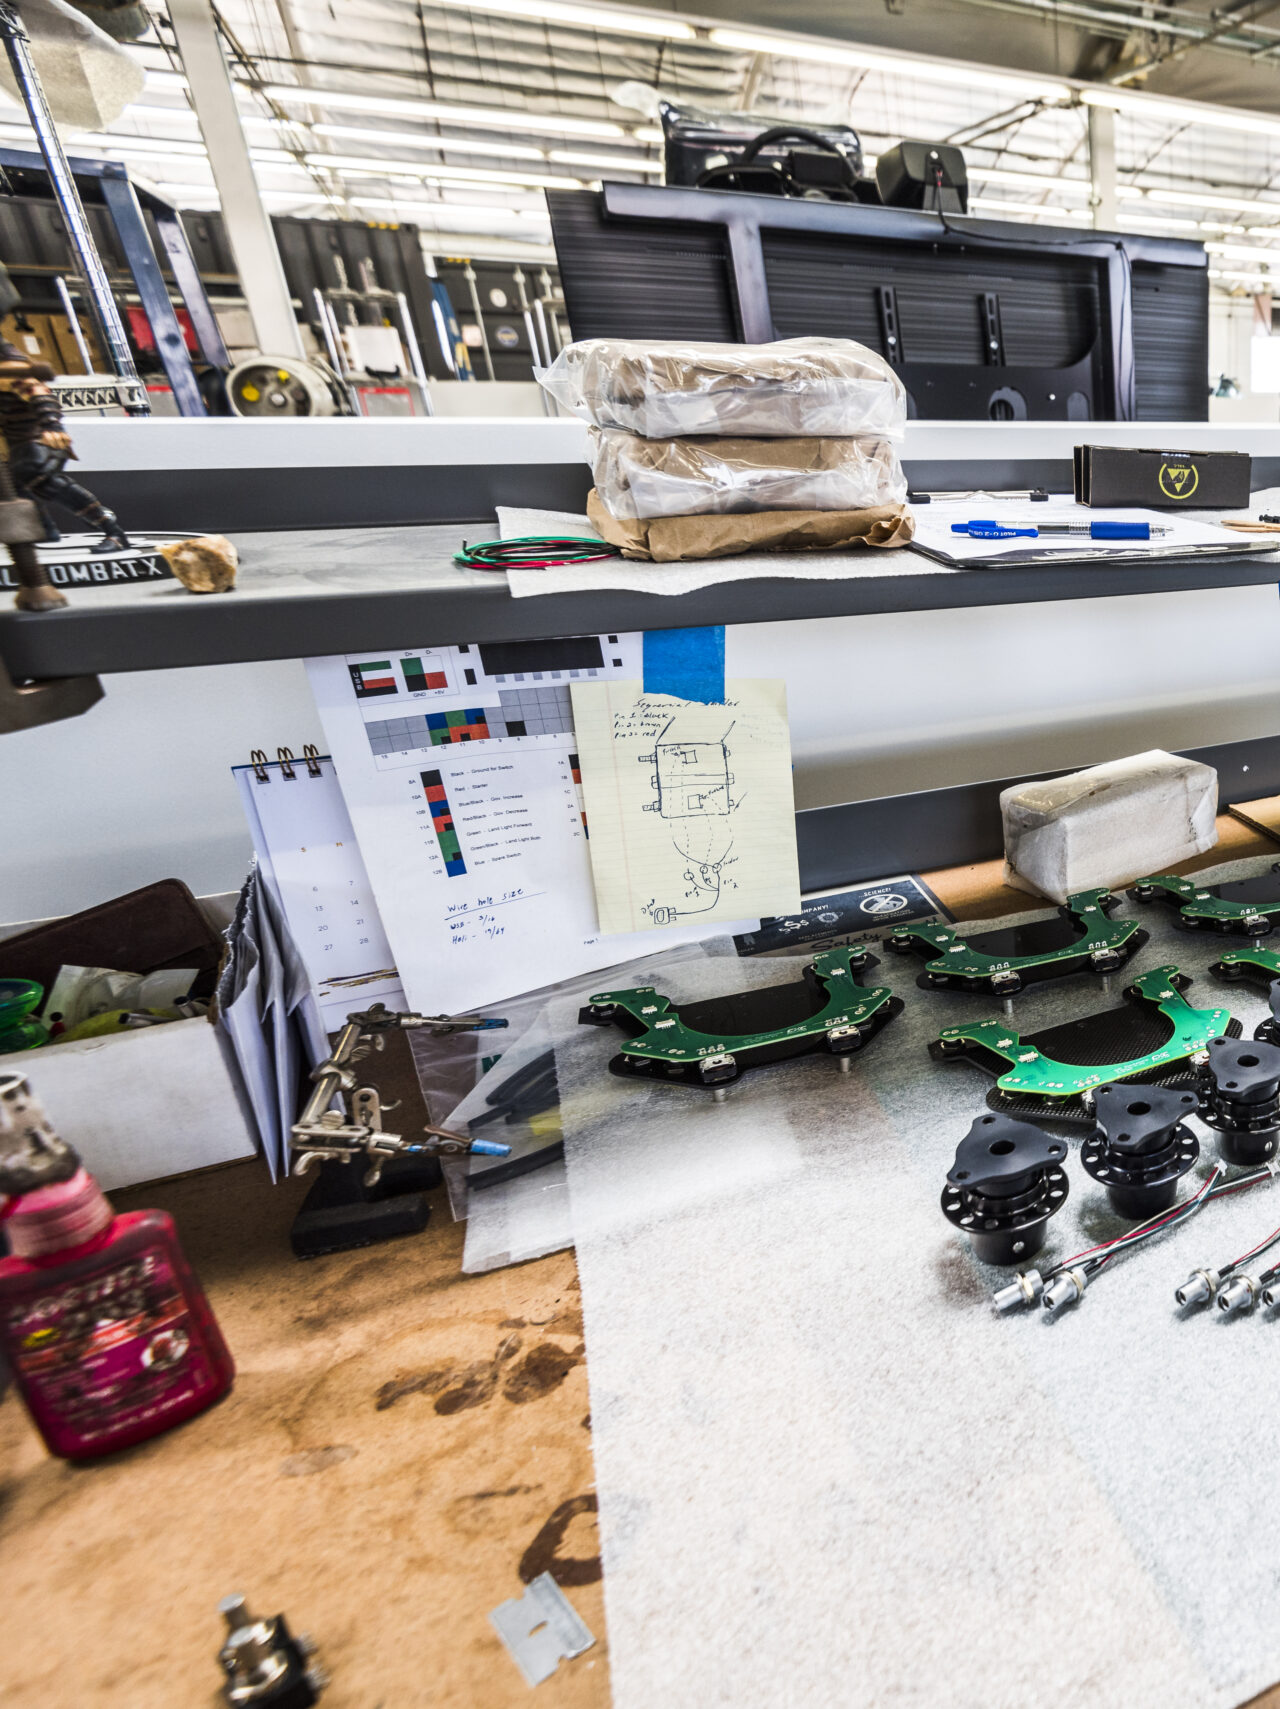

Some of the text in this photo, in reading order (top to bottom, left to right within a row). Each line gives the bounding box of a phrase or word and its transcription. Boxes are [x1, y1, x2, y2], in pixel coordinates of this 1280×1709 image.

[50, 560, 138, 584] OMBAT
[353, 672, 363, 690] USB
[448, 904, 468, 912] Wire
